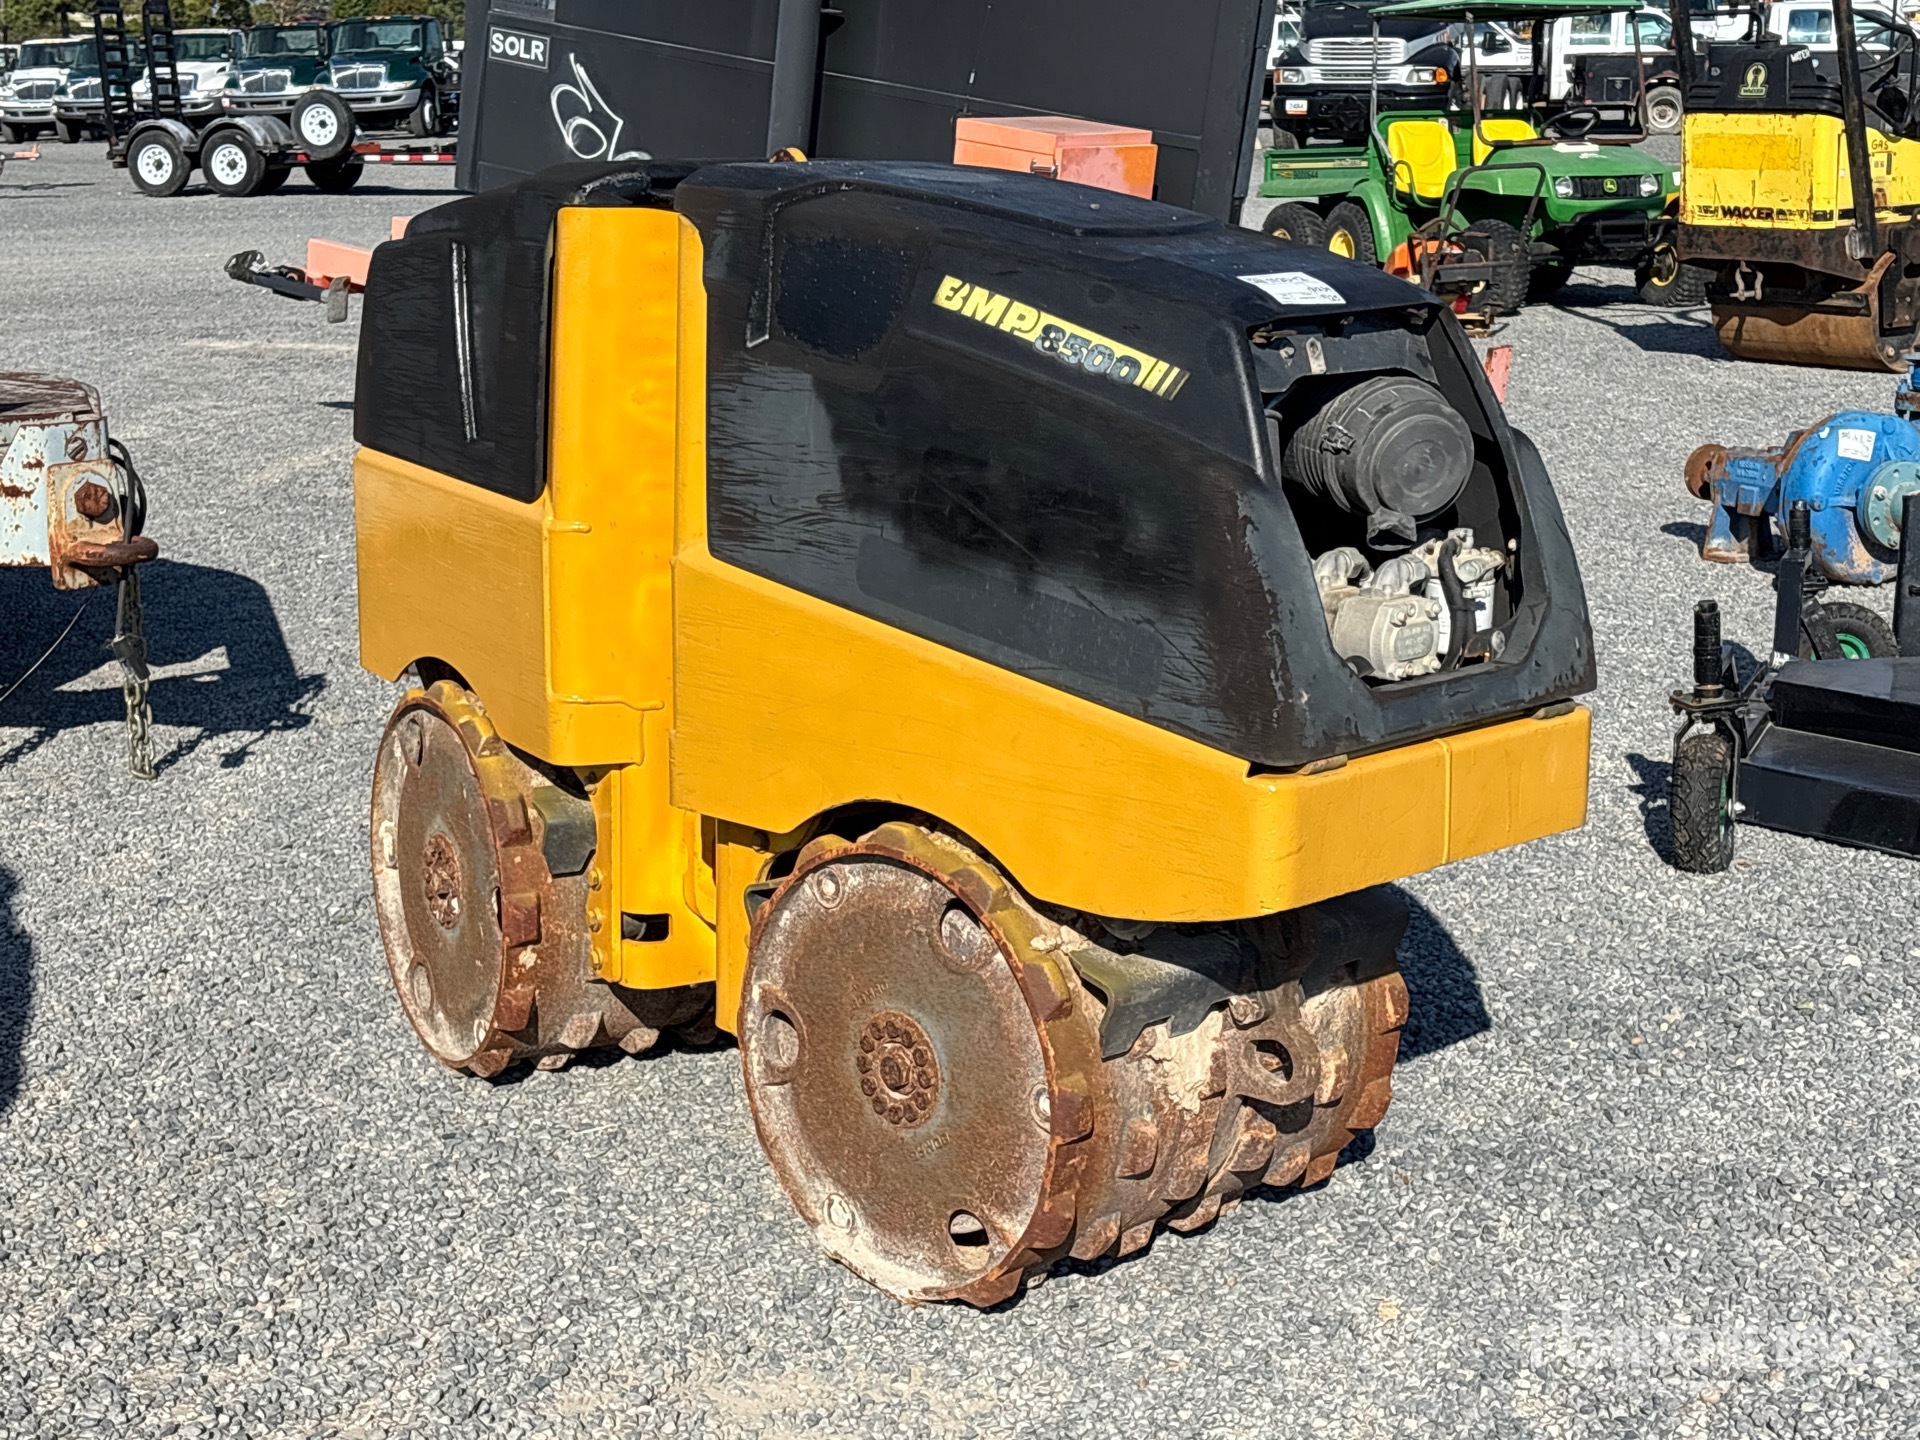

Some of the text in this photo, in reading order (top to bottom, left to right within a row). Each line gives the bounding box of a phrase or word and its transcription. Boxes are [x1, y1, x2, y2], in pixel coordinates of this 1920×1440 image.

[491, 33, 545, 62] SOLR
[1871, 139, 1889, 151] GAS
[1720, 205, 1775, 220] WACKER
